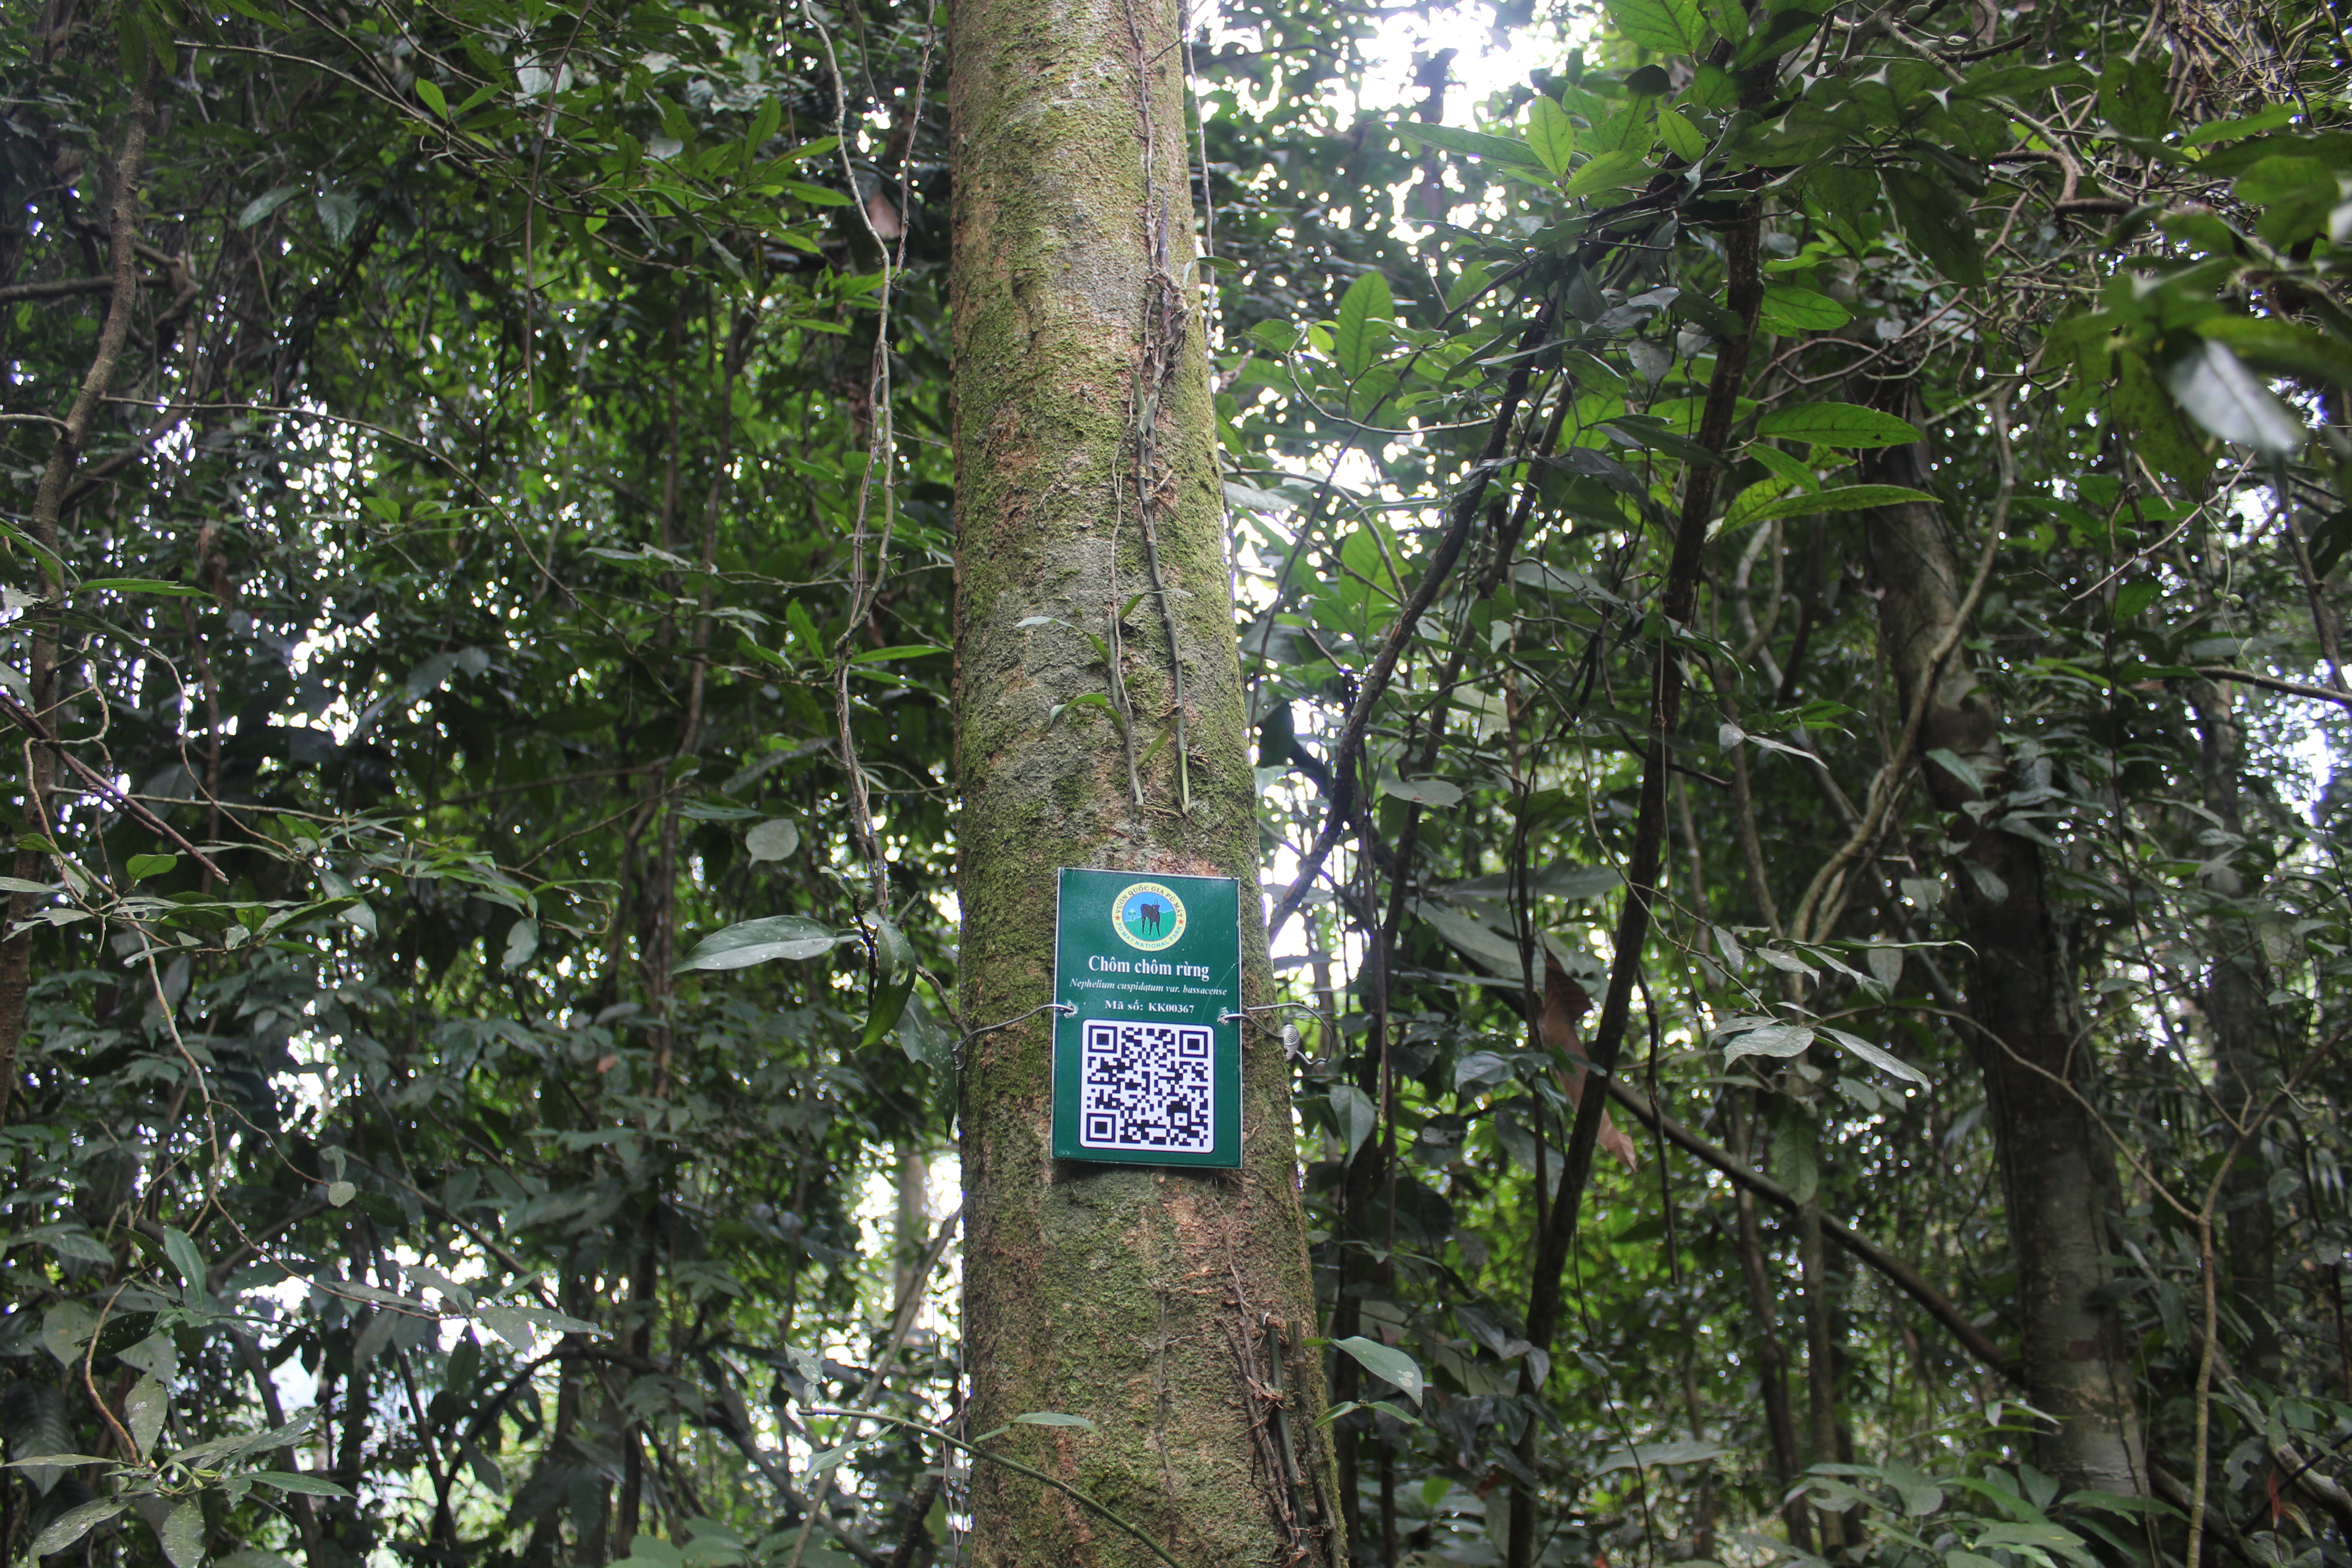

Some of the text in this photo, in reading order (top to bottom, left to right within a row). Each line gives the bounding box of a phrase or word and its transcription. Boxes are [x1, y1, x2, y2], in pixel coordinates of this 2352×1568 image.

[1116, 894, 1128, 913] VƯỜN
[1128, 884, 1149, 896] QUỐC
[1151, 886, 1164, 895] GIA
[1117, 923, 1182, 949] PU MAT NATIONAL PARK
[1088, 955, 1210, 982] Chôm chôm rừng
[1069, 978, 1115, 990] Nephelium
[1183, 985, 1227, 996] bassacense
[1105, 1000, 1195, 1014] Mã số: KK00367
